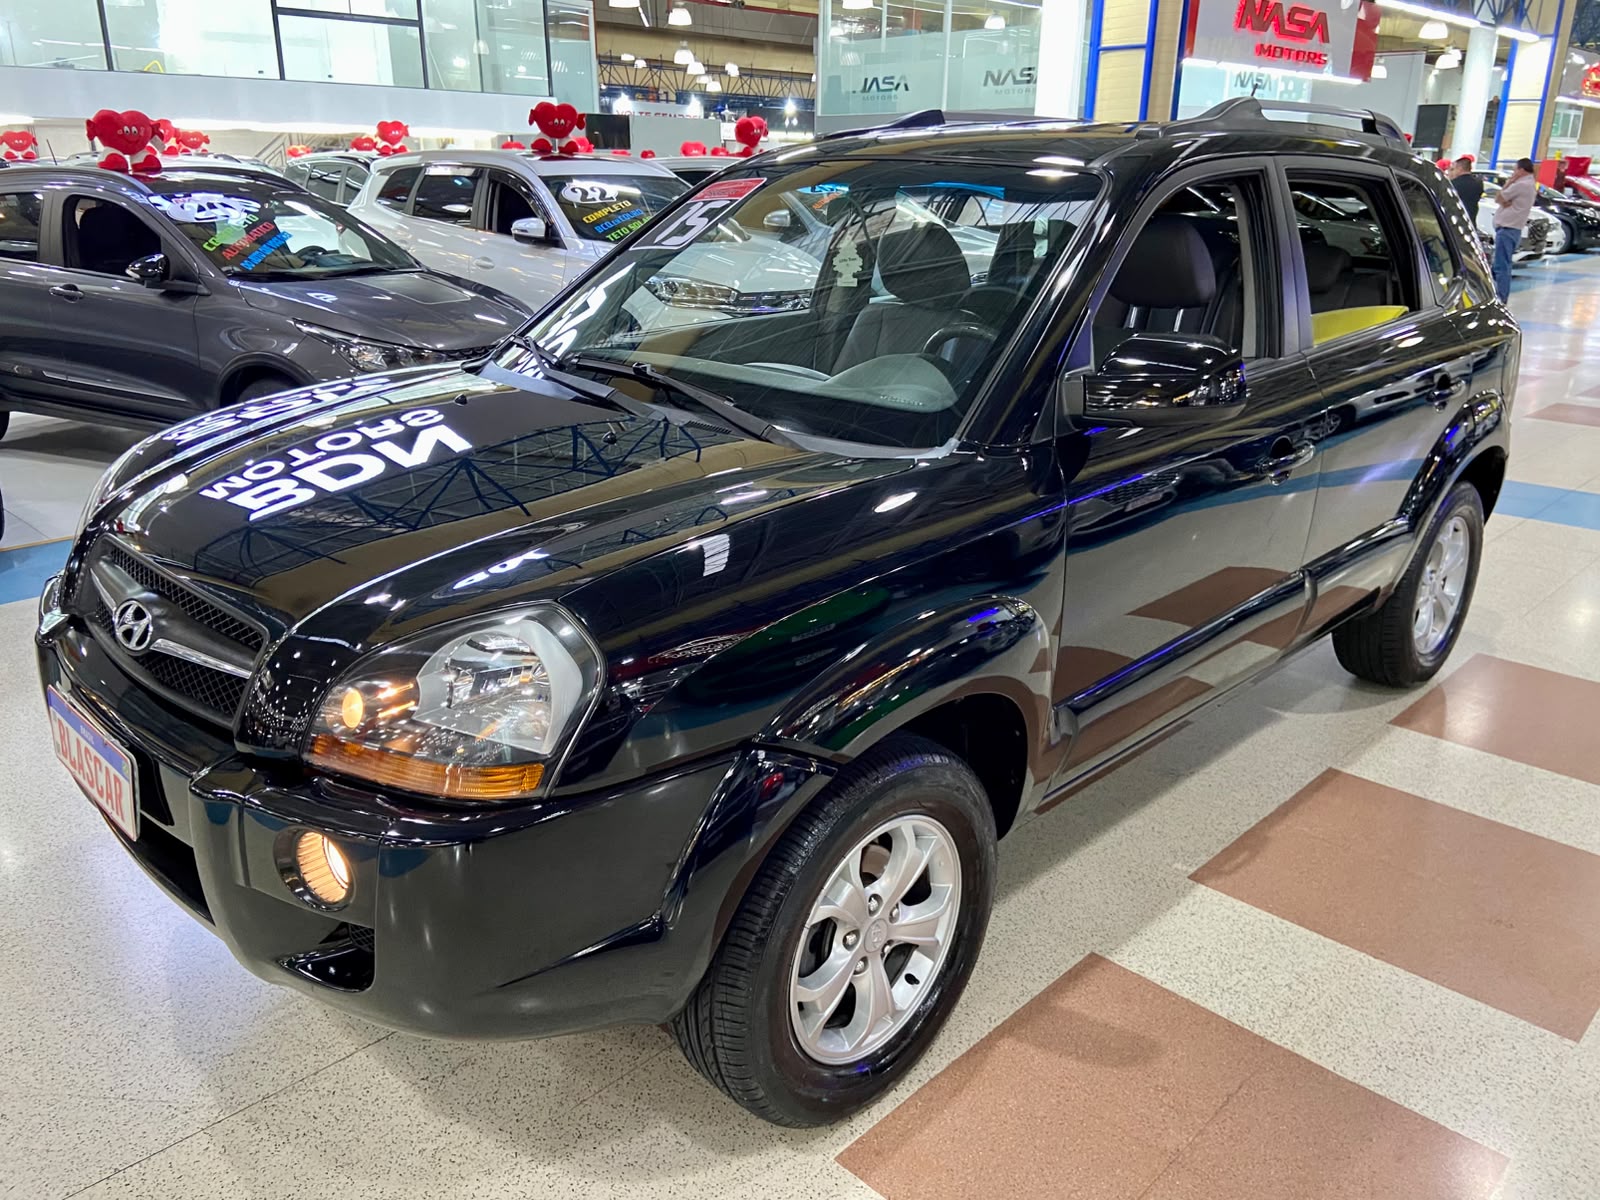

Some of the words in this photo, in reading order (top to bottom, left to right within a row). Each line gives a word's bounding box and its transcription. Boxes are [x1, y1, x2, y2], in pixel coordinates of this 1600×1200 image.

[1235, 0, 1330, 44] NASA
[1256, 43, 1329, 66] MOTORS
[983, 66, 1037, 87] NAS
[570, 186, 617, 203] 22
[582, 200, 632, 224] COMPLETO
[606, 226, 630, 241] TETO
[57, 717, 125, 822] BLASCAR
